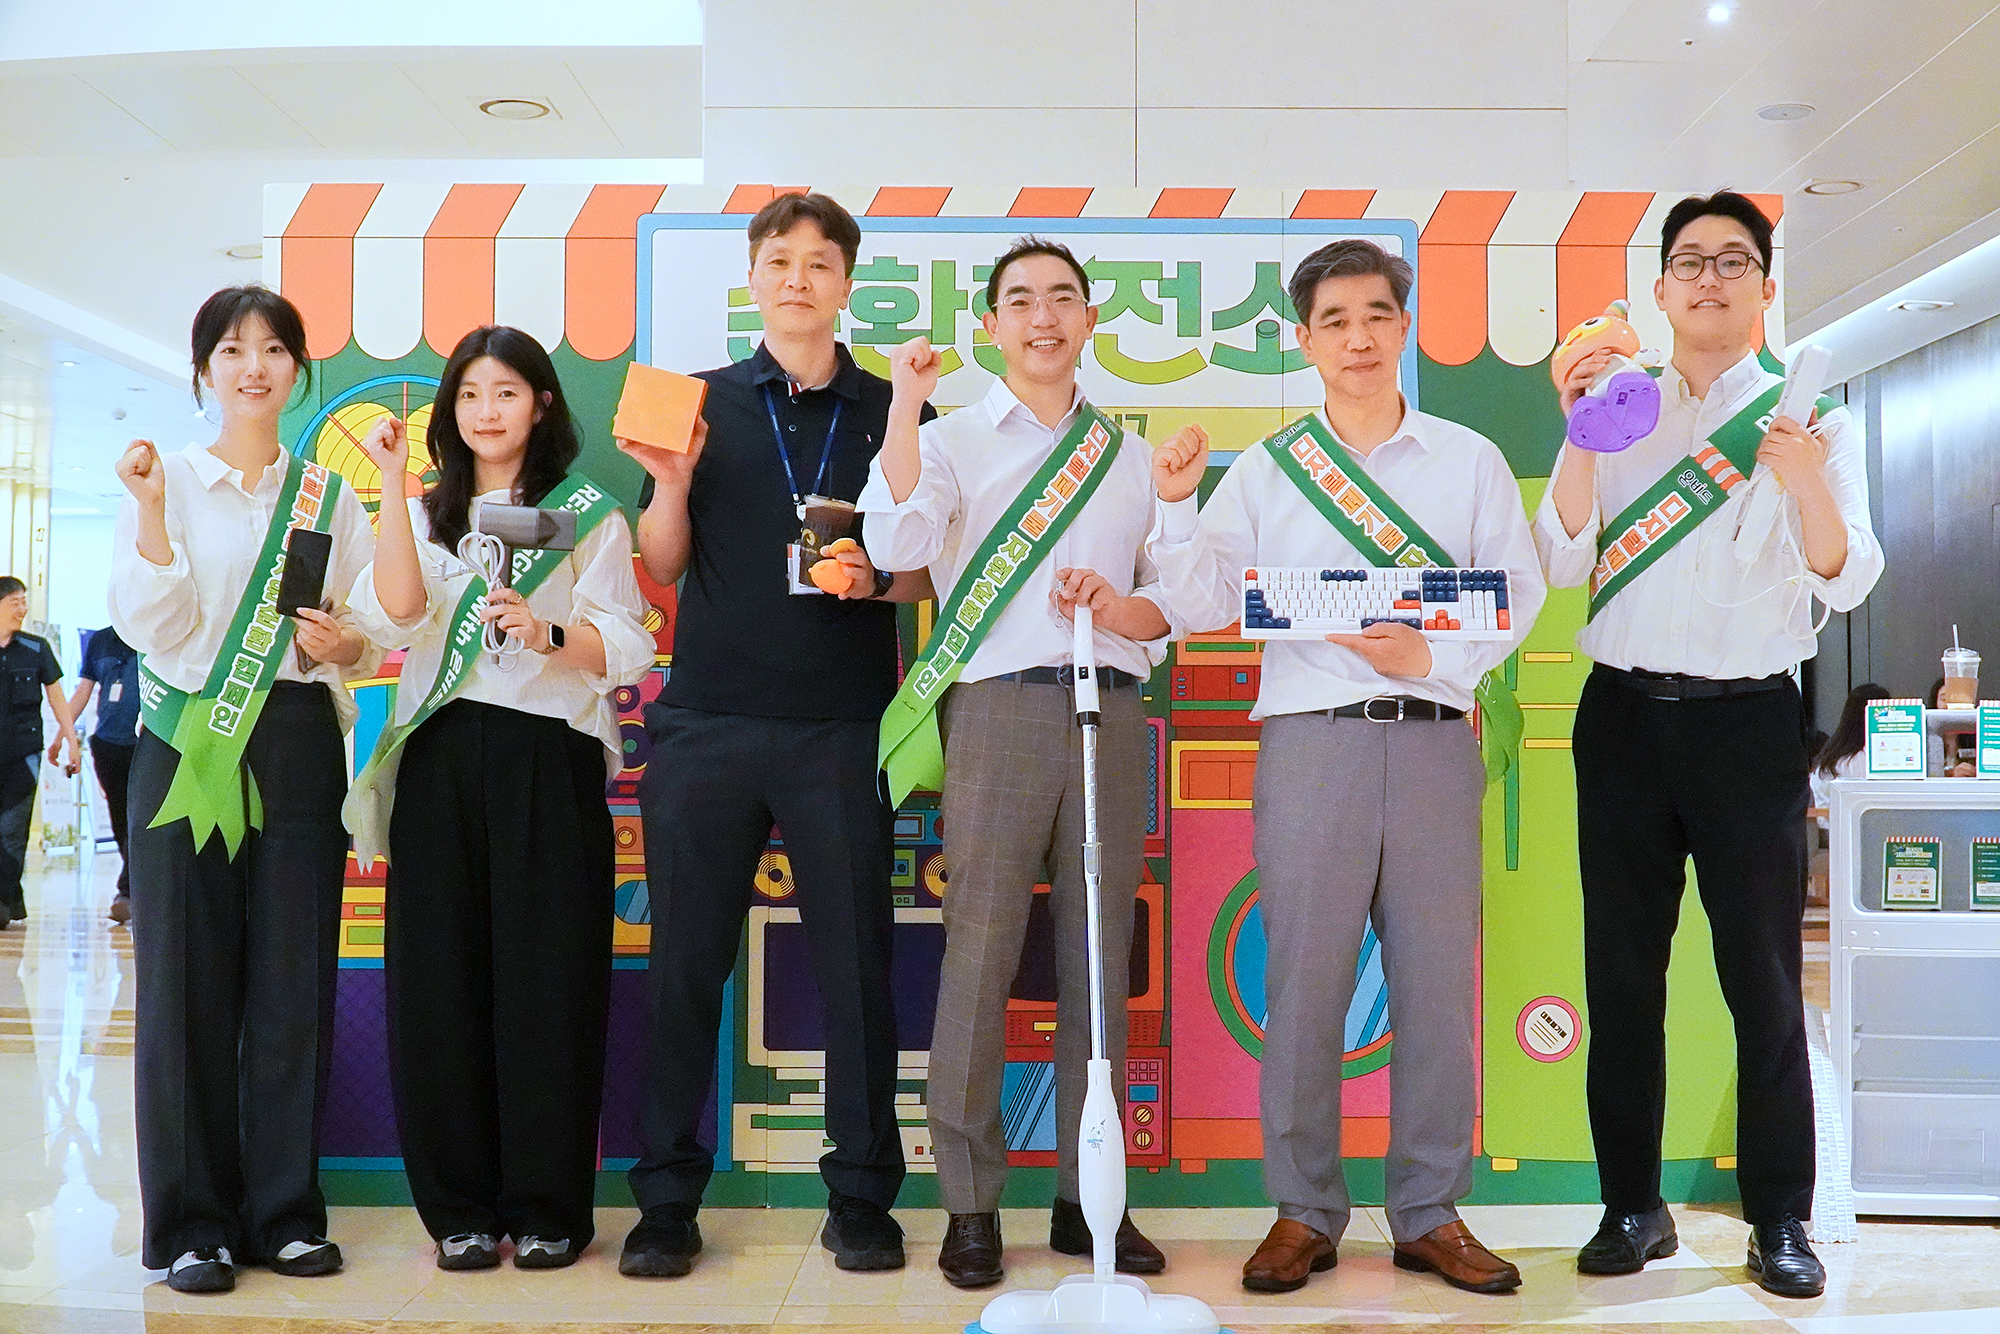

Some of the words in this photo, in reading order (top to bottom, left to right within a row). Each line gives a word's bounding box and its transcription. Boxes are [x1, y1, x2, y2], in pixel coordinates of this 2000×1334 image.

[1019, 420, 1110, 541] 디지털폐기물
[1289, 433, 1407, 554] 디지털폐기물
[1678, 469, 1713, 505] 온비드
[957, 532, 1032, 630] 자원순환
[456, 595, 489, 646] with
[210, 653, 264, 736] 캠페인
[427, 648, 463, 710] 온비드
[914, 624, 968, 698] 캠페인
